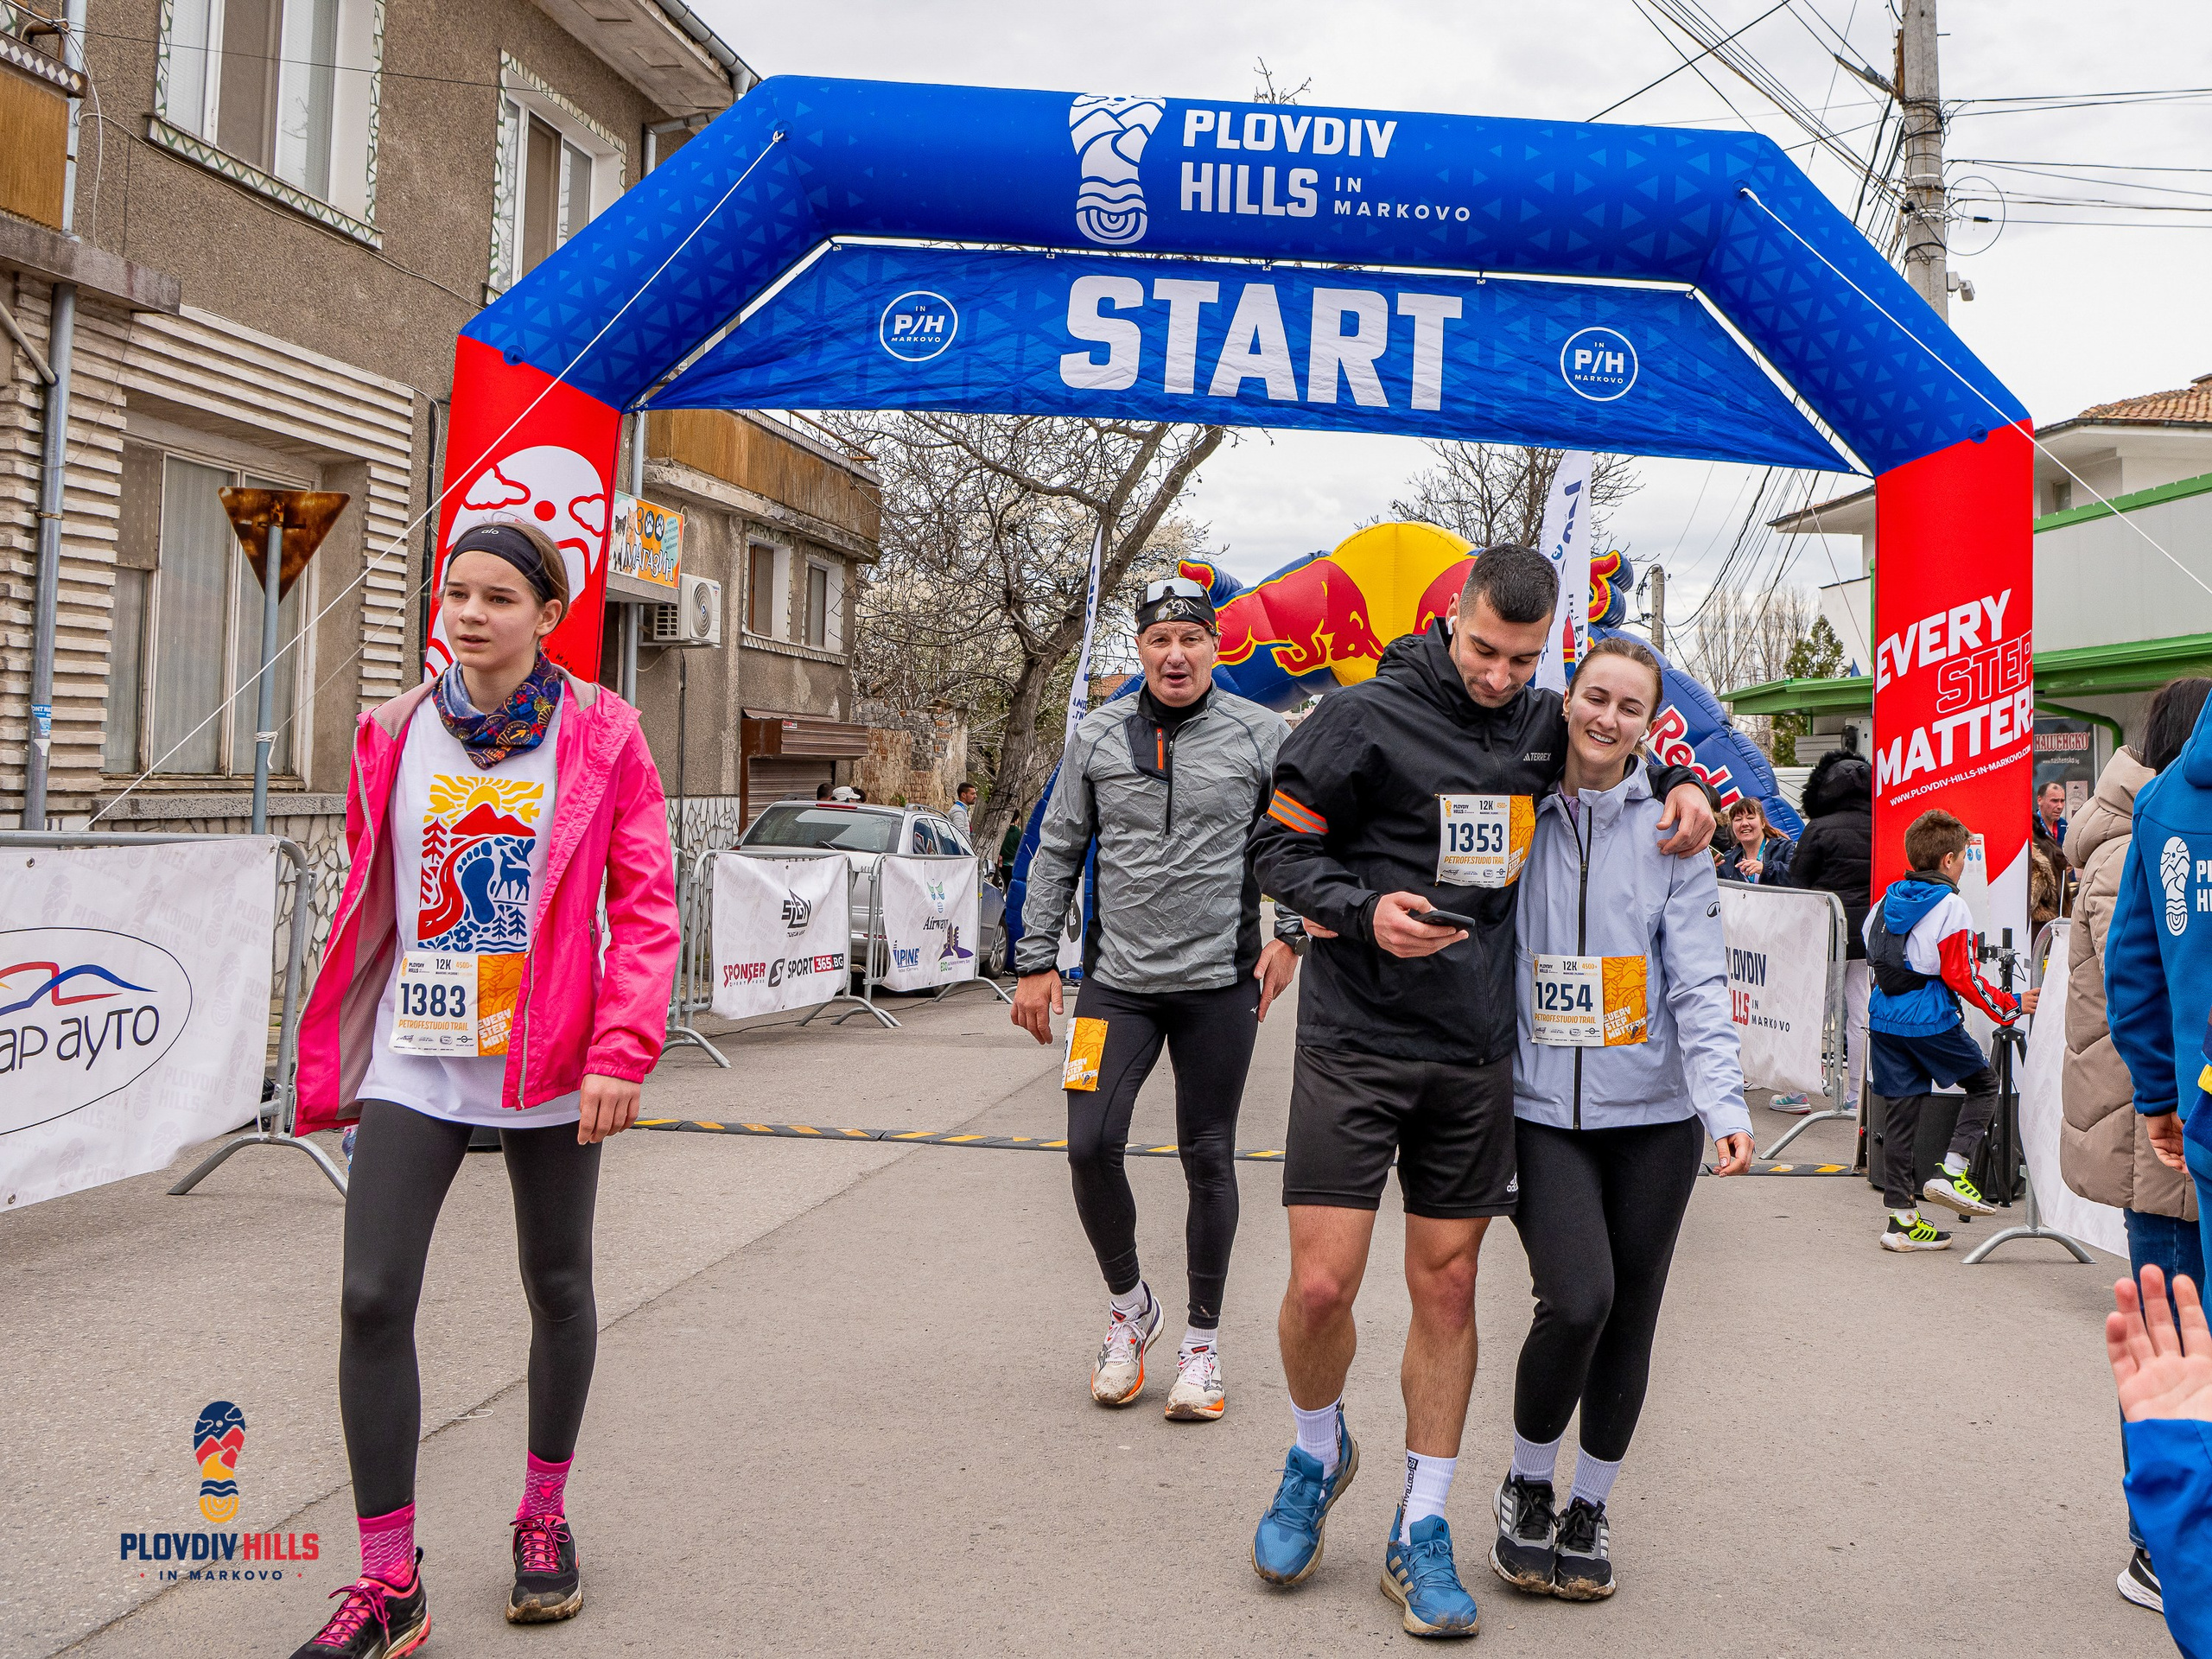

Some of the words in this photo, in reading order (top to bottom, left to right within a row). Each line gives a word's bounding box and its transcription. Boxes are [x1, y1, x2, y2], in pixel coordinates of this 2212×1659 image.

[1182, 109, 1397, 158] PLOVDIV
[1180, 162, 1319, 218] HILLS
[1335, 176, 1361, 193] IN
[1334, 200, 1470, 224] MARKOVO
[893, 314, 945, 335] P/H
[1059, 275, 1462, 411] START
[1574, 348, 1624, 374] P/H
[1574, 374, 1624, 385] MARKOVO
[625, 543, 674, 582] МАГАЗИН
[1877, 588, 2012, 694] EVERY
[1936, 630, 2032, 714] STEP
[1530, 752, 1552, 761] TERREX
[1479, 800, 1494, 810] 12K
[1447, 823, 1503, 853] 1353
[436, 959, 452, 970] 12K
[723, 962, 766, 988] SPONSER
[1562, 961, 1578, 971] 12K
[401, 982, 466, 1018] 1383
[1535, 981, 1593, 1013] 1254
[1751, 999, 1759, 1010] IN
[451, 1020, 469, 1031] TRAIL
[1579, 1014, 1597, 1025] TRAIL
[1605, 1016, 1628, 1032] STEP
[1751, 1014, 1790, 1033] MARKOVO
[479, 1022, 508, 1039] STEP
